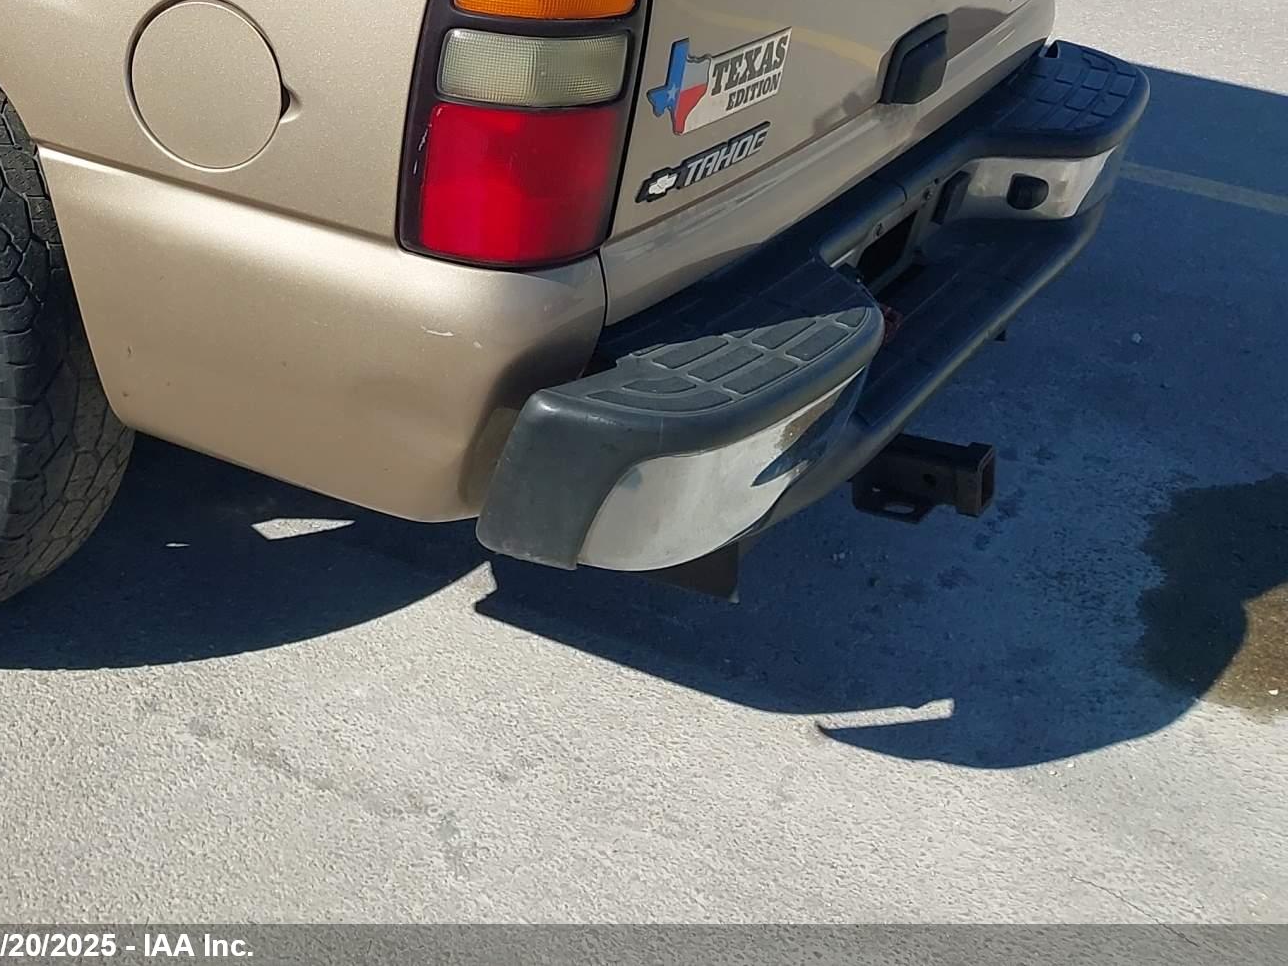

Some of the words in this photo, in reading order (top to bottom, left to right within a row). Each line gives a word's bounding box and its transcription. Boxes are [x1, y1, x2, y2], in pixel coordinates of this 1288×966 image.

[711, 34, 789, 96] TEXAS
[726, 72, 781, 111] EDITION
[683, 128, 770, 187] TAHOE
